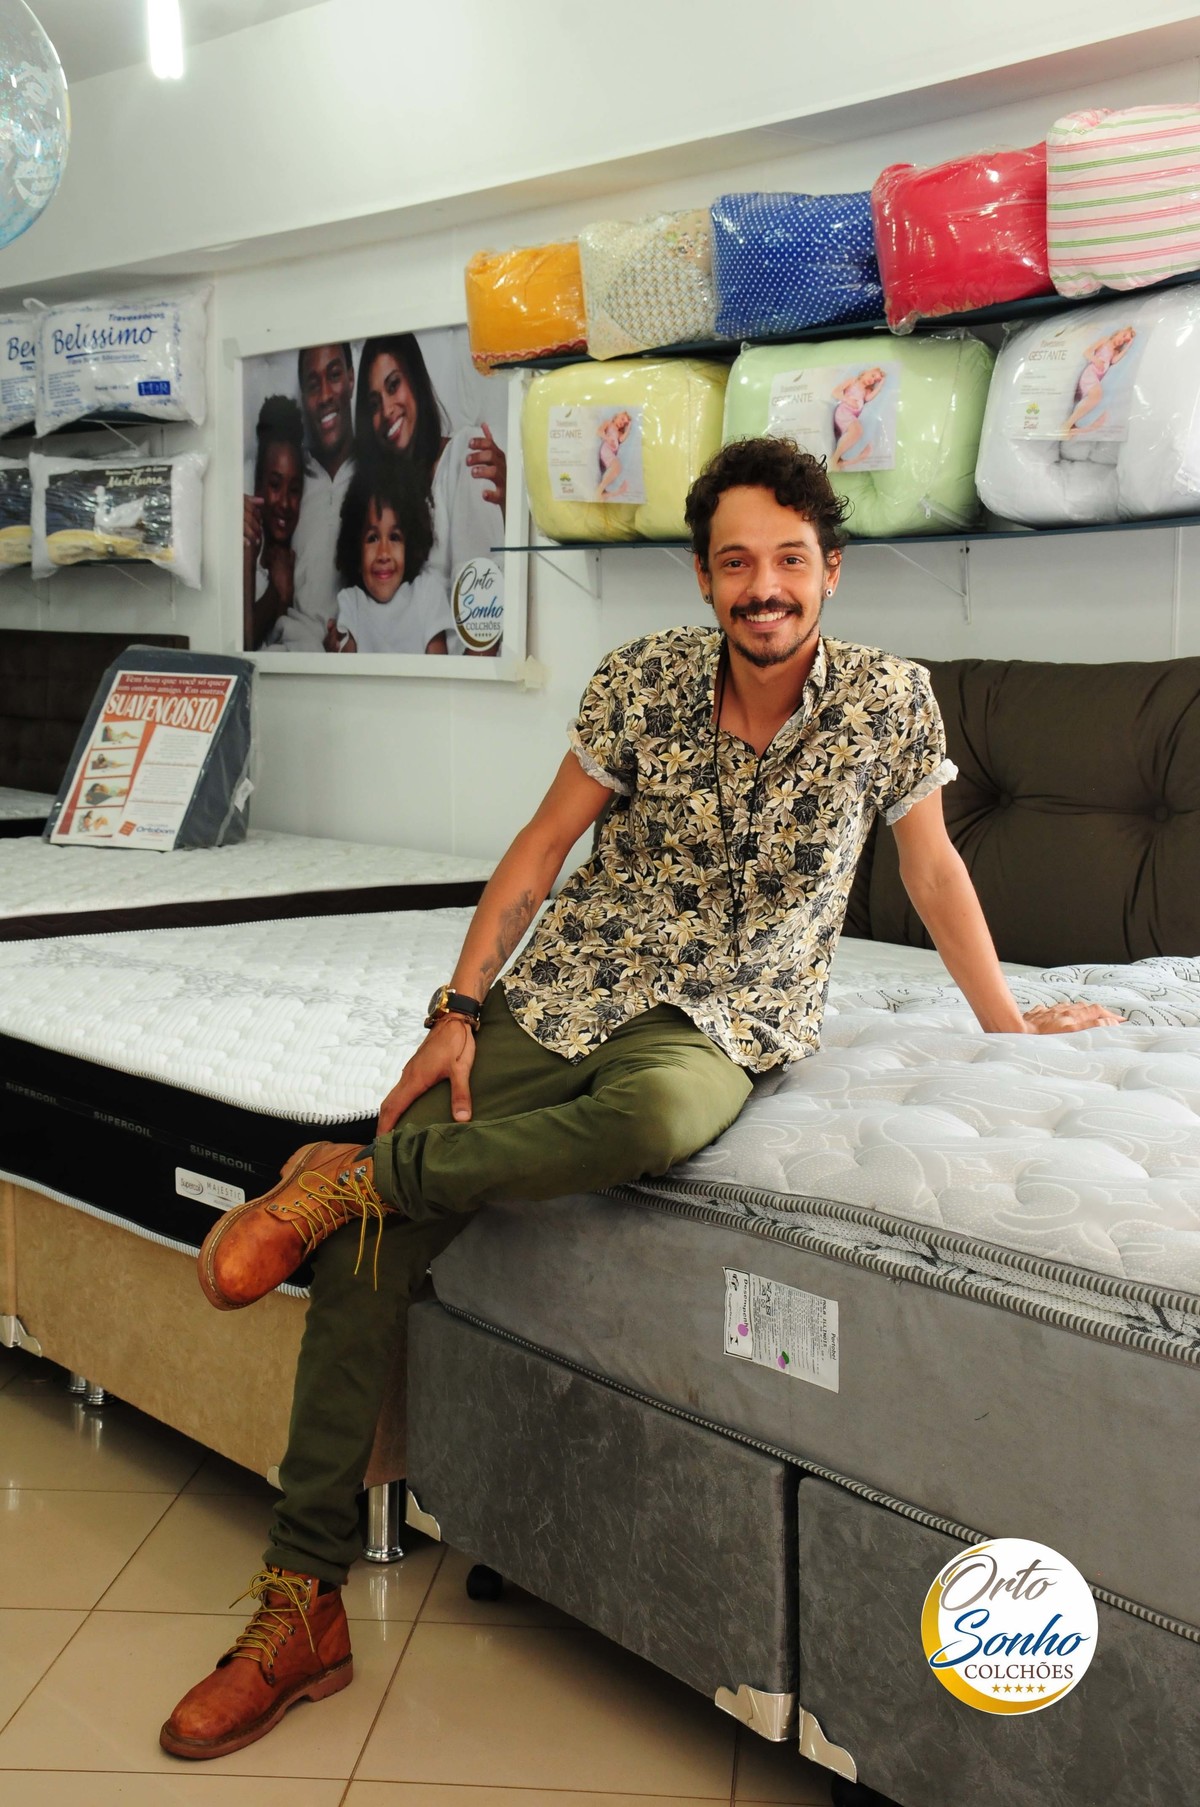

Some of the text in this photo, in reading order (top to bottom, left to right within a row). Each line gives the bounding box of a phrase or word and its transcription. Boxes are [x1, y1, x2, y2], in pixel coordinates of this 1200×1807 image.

[1029, 350, 1068, 361] GESTANTE
[550, 429, 583, 439] GESTANTE
[459, 566, 497, 596] Orto
[456, 594, 504, 624] Sonho
[466, 620, 501, 631] COLCHÕES
[131, 685, 157, 693] ombro
[162, 678, 177, 686] que
[179, 677, 197, 686] você
[207, 679, 226, 687] quer
[5, 1081, 58, 1105] SUPERCOIL
[93, 1110, 153, 1138] SUPERCOIL
[189, 1143, 256, 1174] SUPERCOIL
[206, 1181, 242, 1201] MAJESTIC
